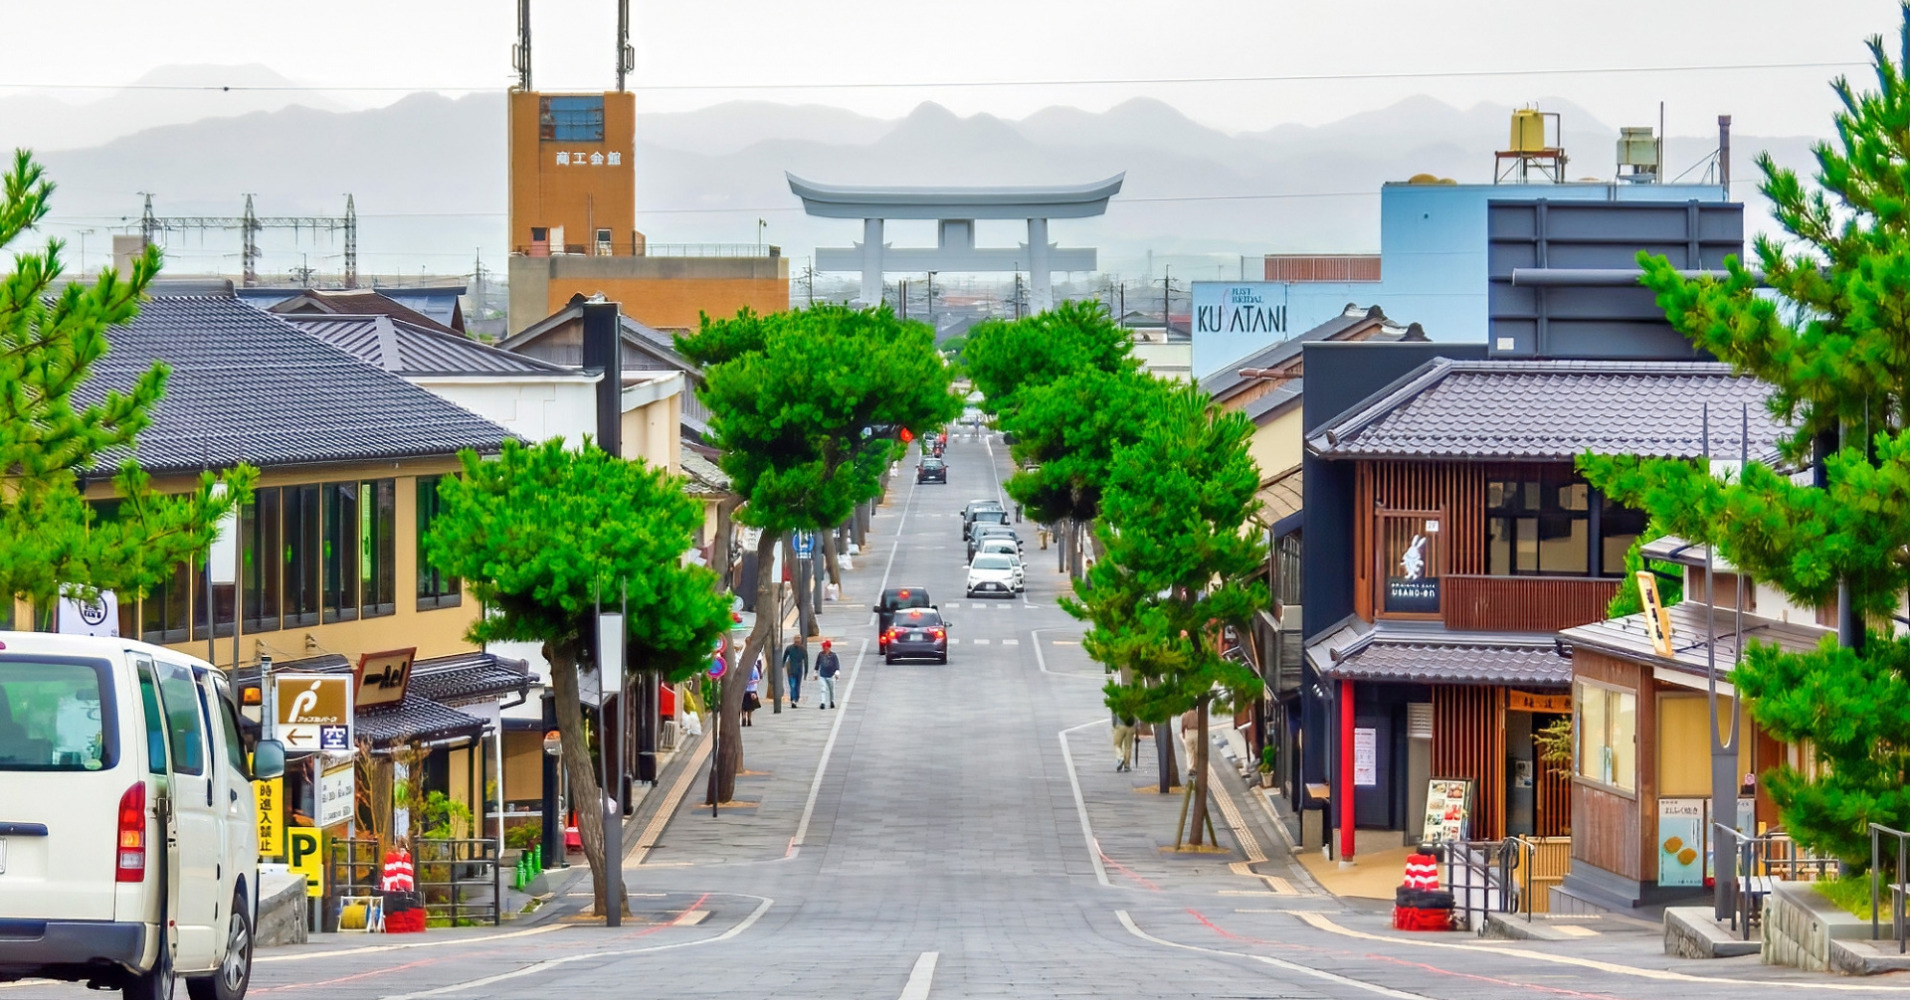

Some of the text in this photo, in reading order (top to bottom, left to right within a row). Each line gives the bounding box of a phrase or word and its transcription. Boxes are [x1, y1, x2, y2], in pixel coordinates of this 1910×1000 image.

[556, 151, 621, 166] 商工会館
[323, 725, 346, 749] 空
[291, 833, 317, 867] P
